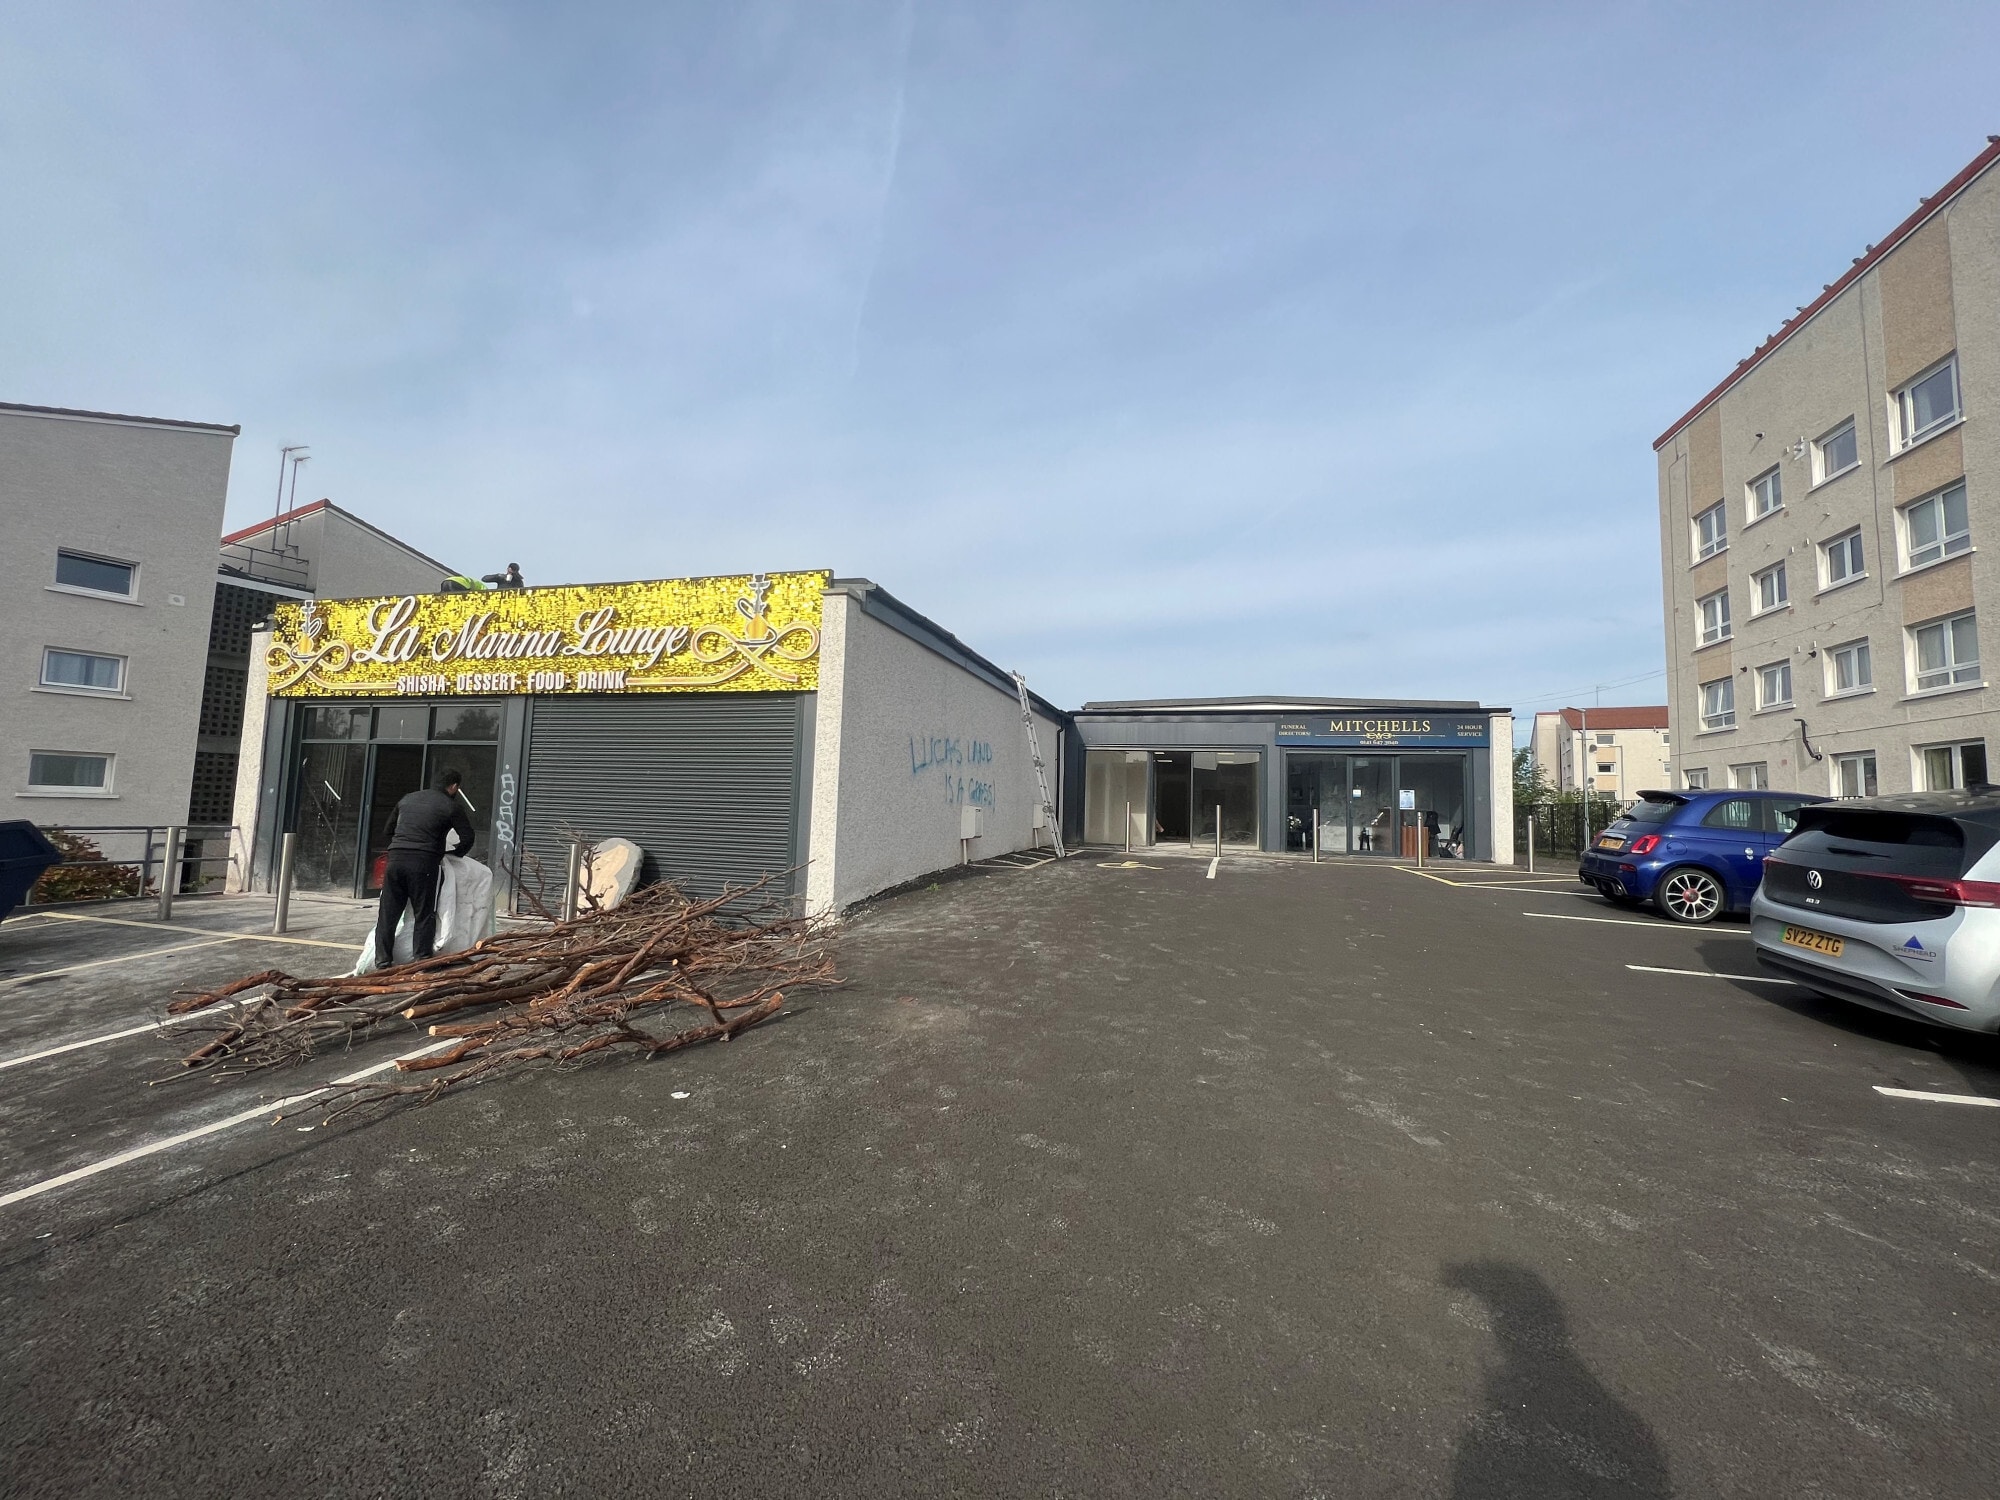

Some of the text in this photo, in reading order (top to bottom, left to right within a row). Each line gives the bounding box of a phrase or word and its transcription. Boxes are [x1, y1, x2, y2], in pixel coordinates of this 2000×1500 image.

[352, 595, 689, 670] La Marina Lounge
[577, 668, 627, 690] DRINK
[1329, 719, 1431, 733] MITCHELLS
[910, 736, 963, 774] LUCAS
[957, 777, 964, 803] A
[1785, 928, 1842, 953] SV22 ZTG
